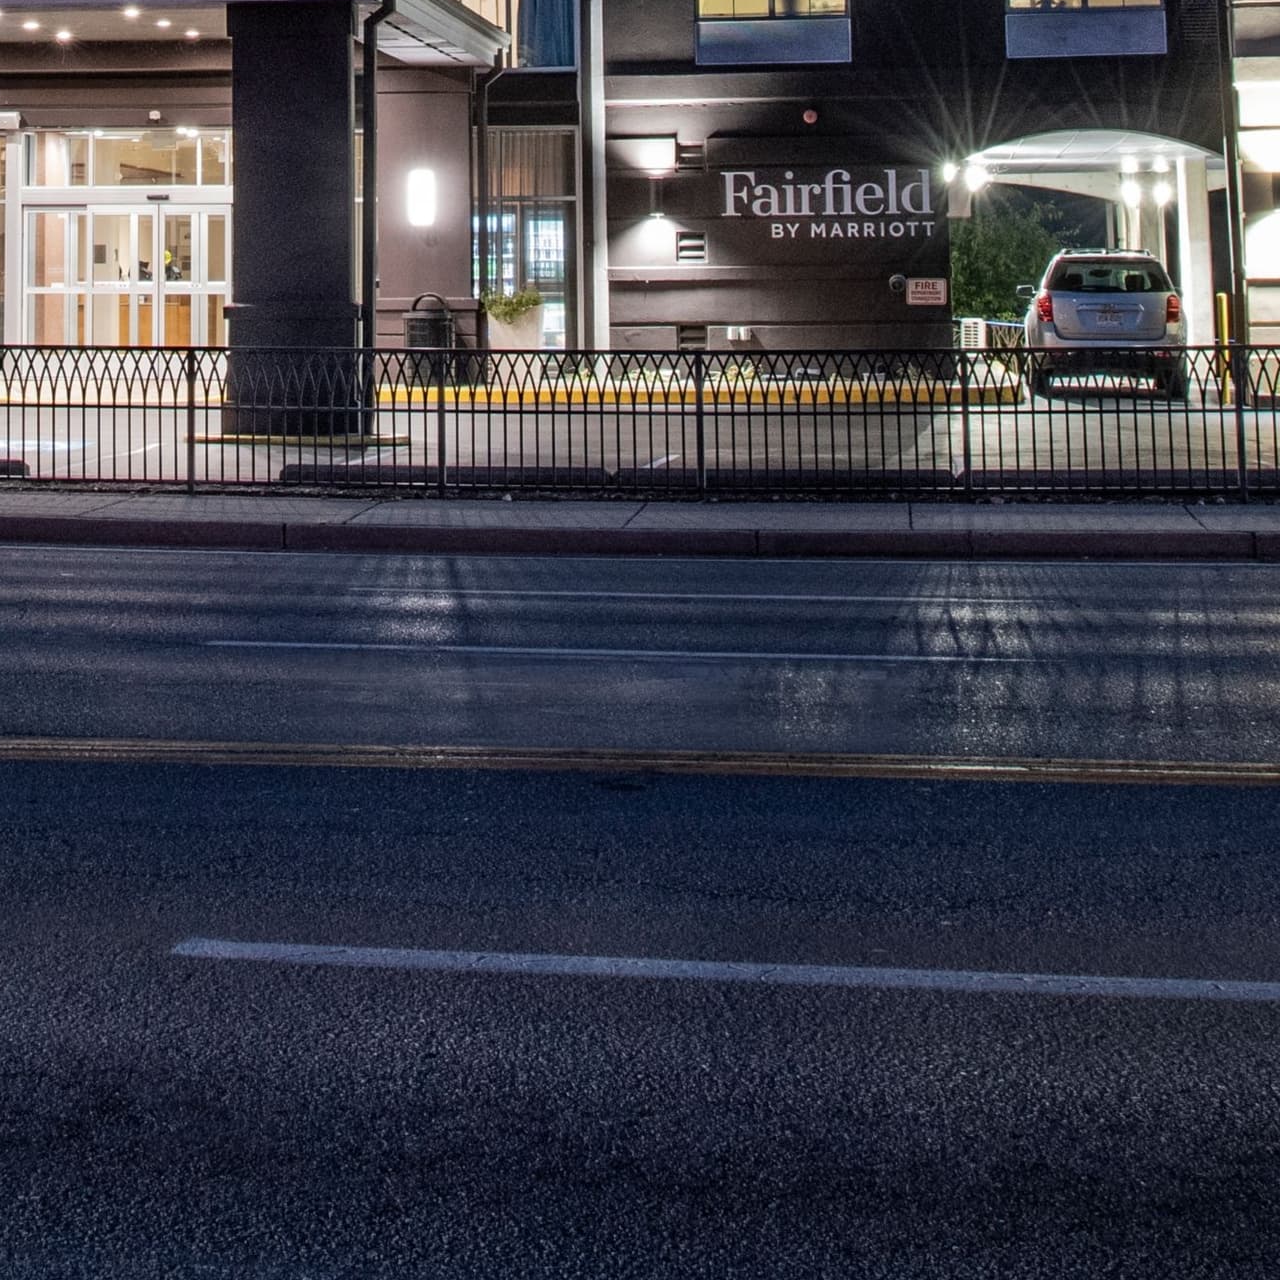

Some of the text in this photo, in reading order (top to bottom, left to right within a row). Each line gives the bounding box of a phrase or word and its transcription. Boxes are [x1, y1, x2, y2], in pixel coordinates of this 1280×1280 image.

[720, 169, 935, 217] Fairfield
[771, 221, 935, 238] BY MARRIOTT
[914, 281, 939, 290] FIRE
